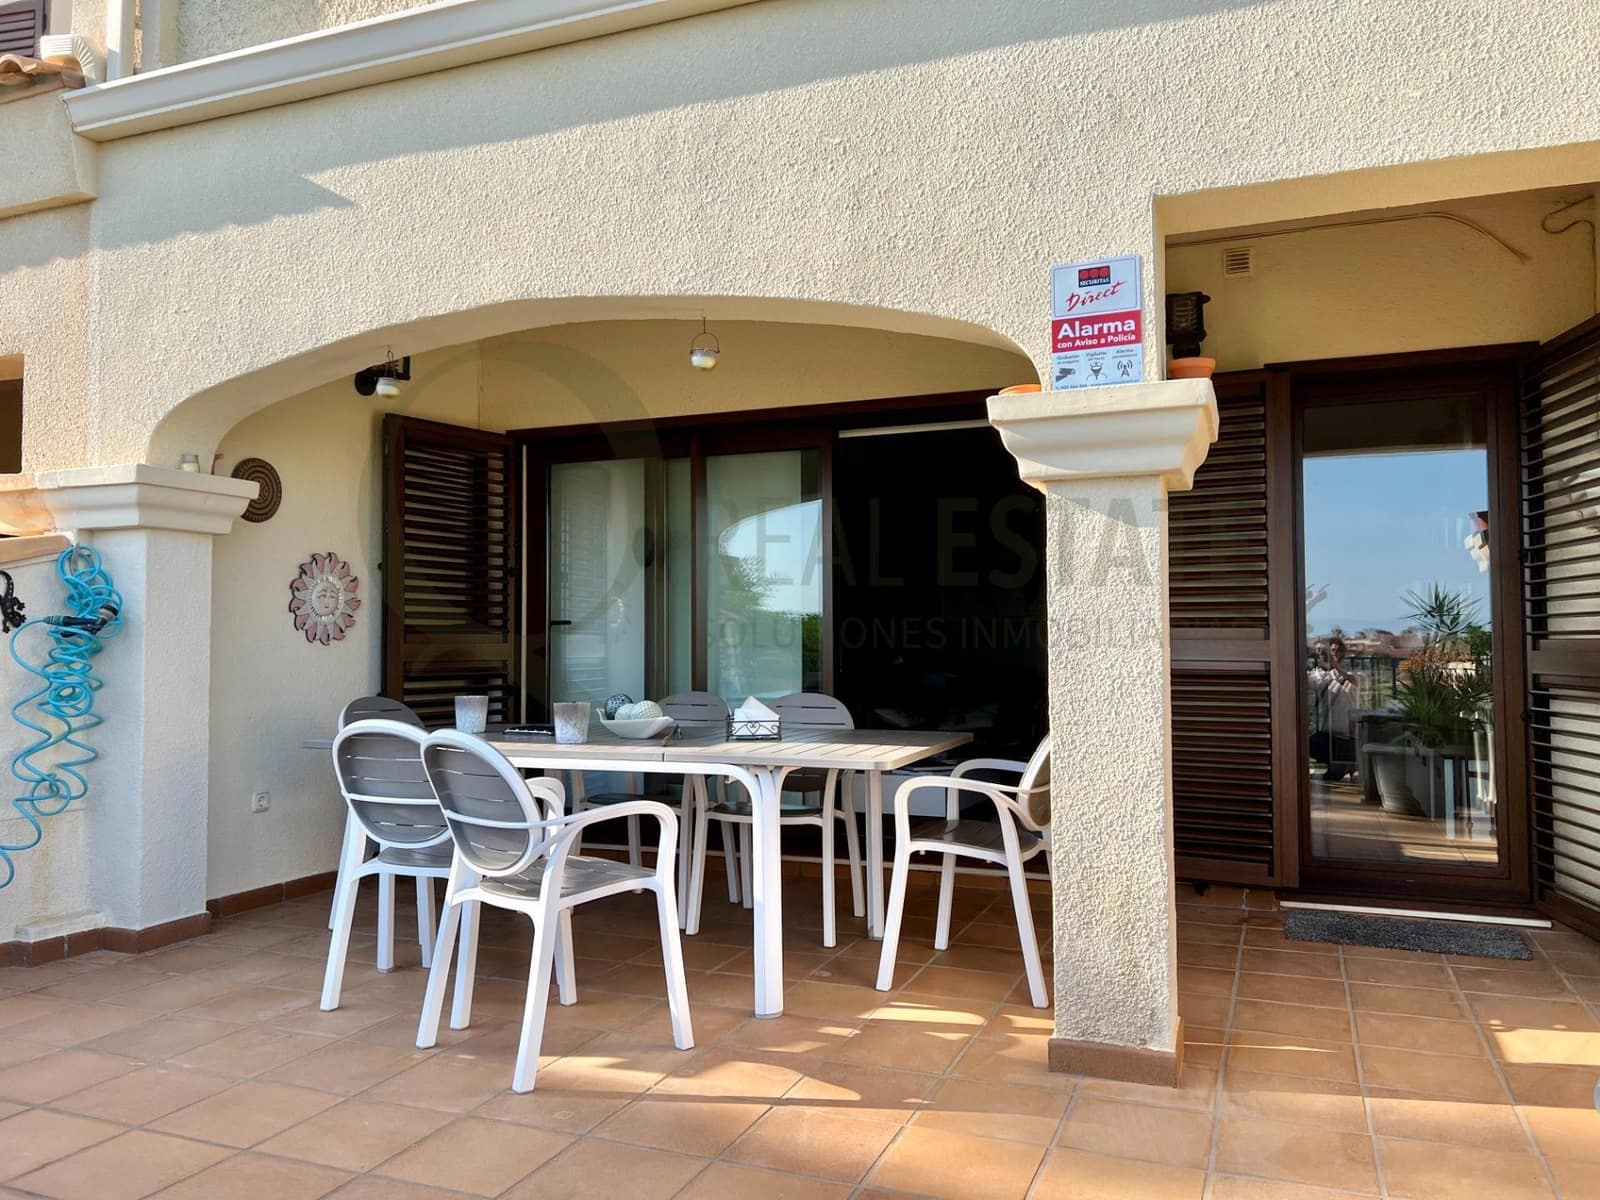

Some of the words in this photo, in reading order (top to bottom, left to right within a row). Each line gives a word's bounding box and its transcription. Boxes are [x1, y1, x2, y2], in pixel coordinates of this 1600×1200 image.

[1079, 278, 1109, 287] SECURITAS
[1066, 281, 1128, 312] Direct
[1057, 320, 1136, 339] Alarma
[1075, 338, 1097, 347] Aviso
[1107, 333, 1136, 343] Policía
